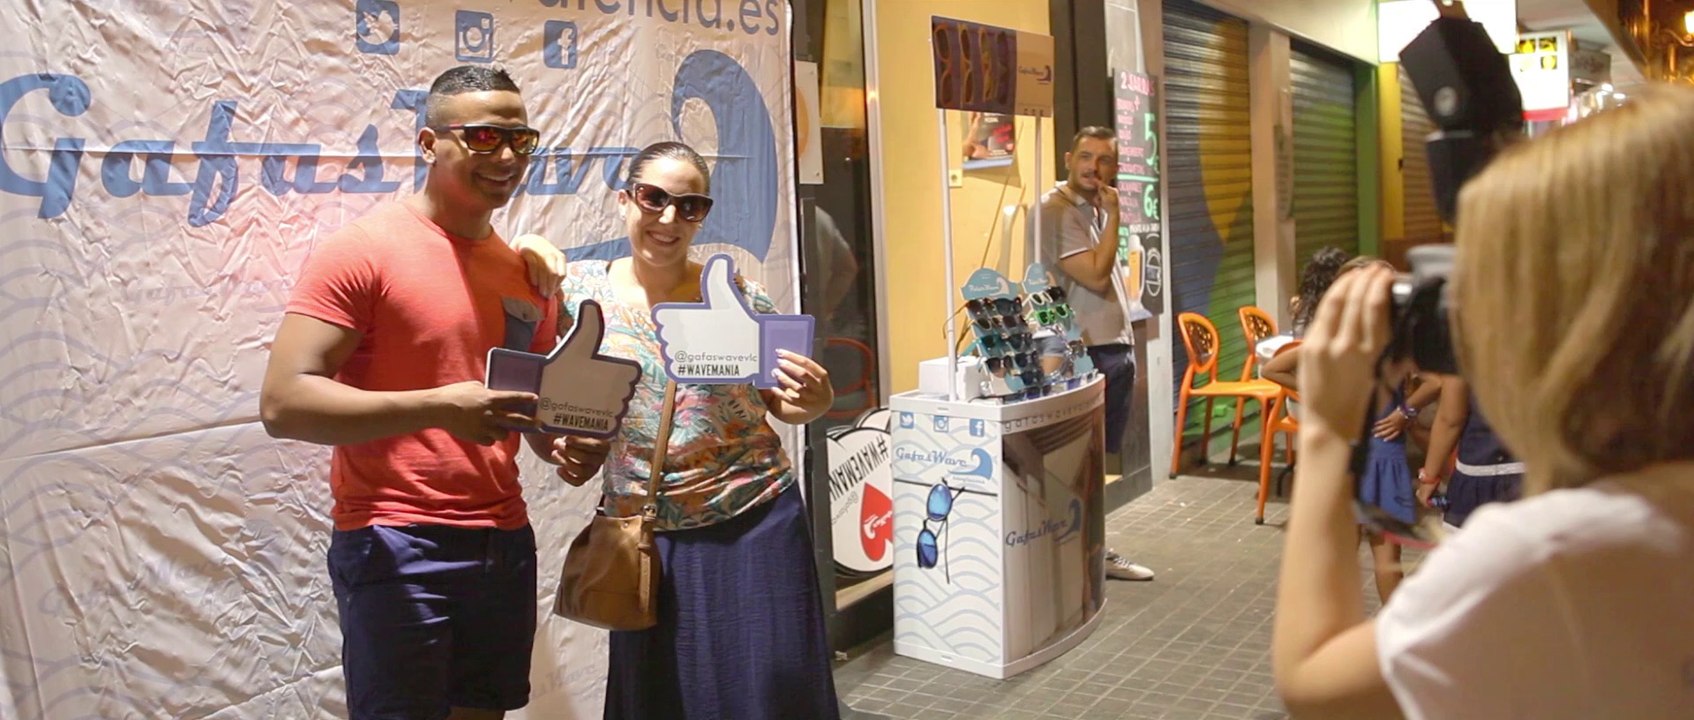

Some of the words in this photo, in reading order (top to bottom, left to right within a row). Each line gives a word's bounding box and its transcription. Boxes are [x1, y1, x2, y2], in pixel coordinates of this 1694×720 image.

[0, 73, 641, 228] Gafasave
[674, 350, 758, 363] @gafaswavevlc
[677, 363, 740, 376] #WAVEMANIA
[553, 412, 609, 431] #WAVEMANIA
[895, 447, 968, 468] GafasWave
[828, 434, 889, 502] #WAVEMAN
